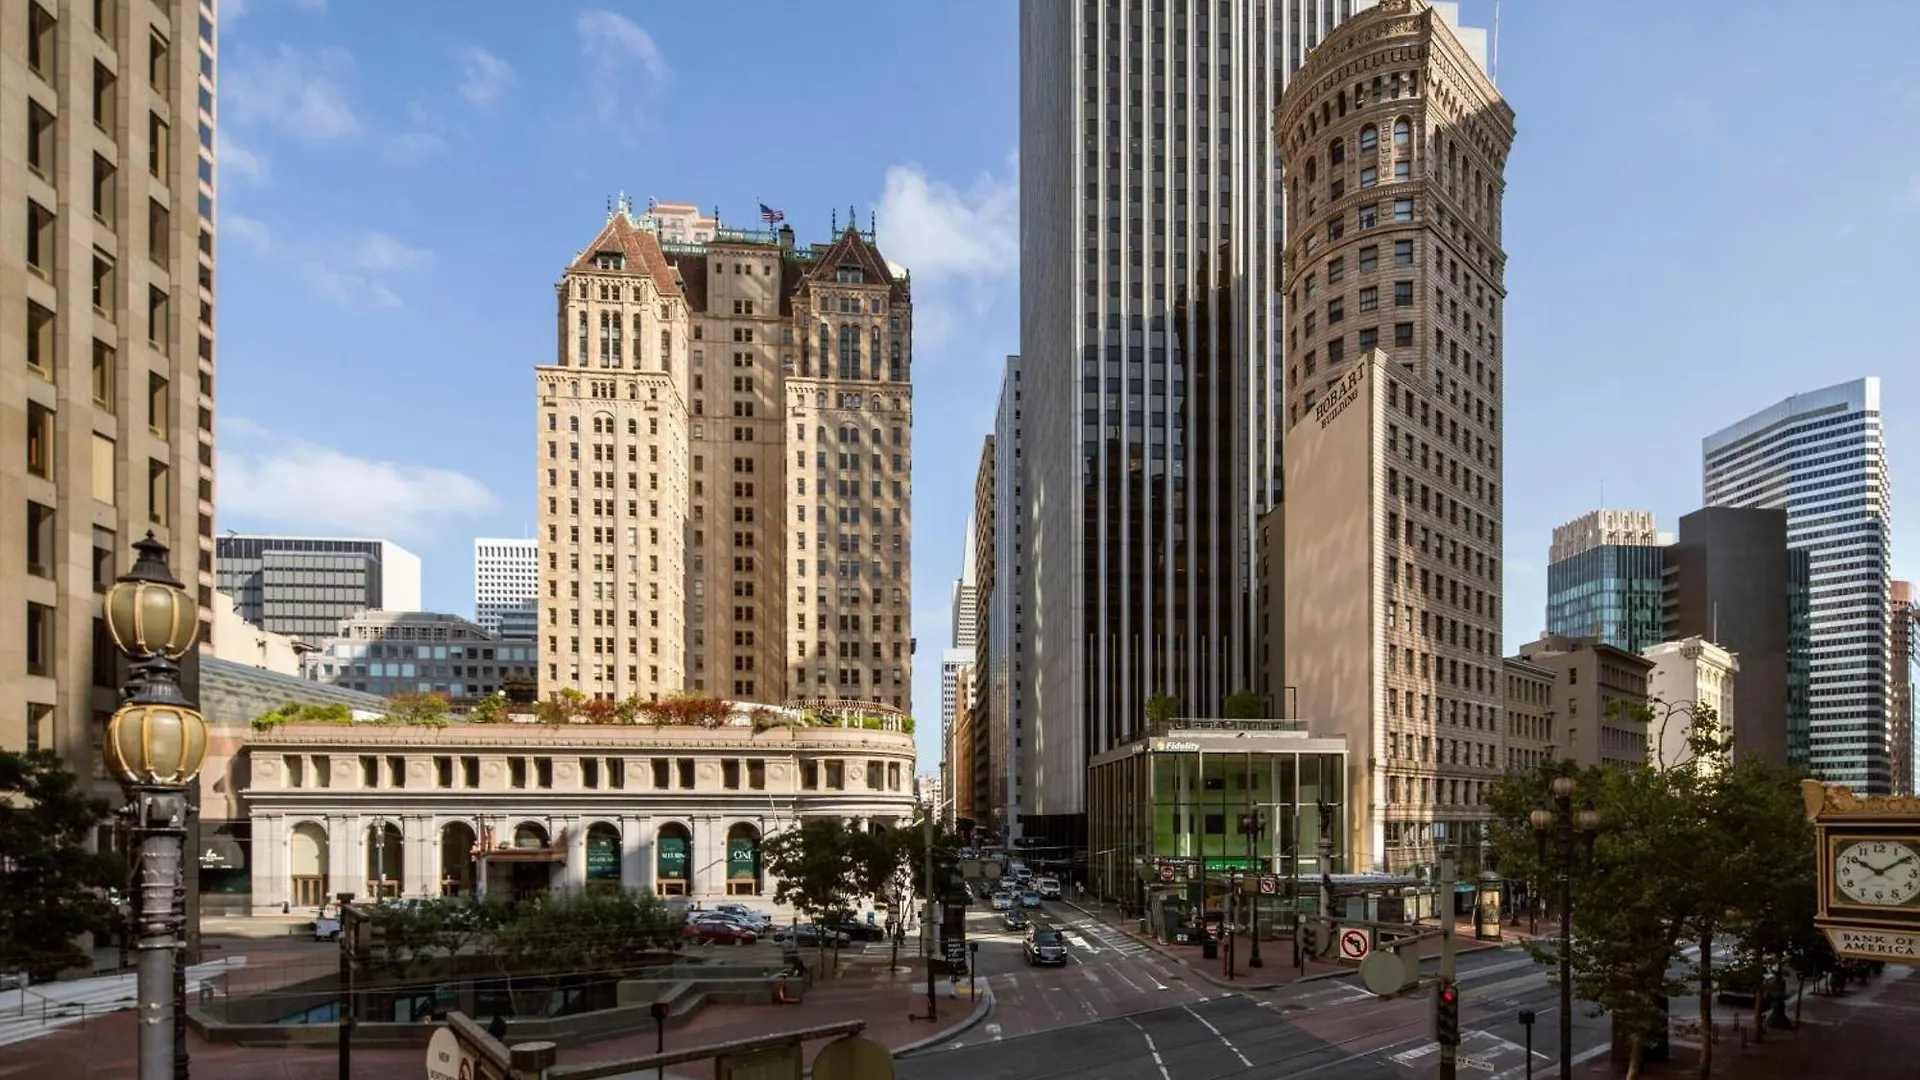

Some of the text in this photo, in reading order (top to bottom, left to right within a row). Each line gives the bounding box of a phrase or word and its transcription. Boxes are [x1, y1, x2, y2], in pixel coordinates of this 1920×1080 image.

[1316, 362, 1364, 422] HOBART
[1321, 389, 1358, 430] BUILDING
[1166, 741, 1199, 751] Fidelity
[1843, 934, 1914, 946] BANK OF
[1844, 943, 1914, 955] AMERICA
